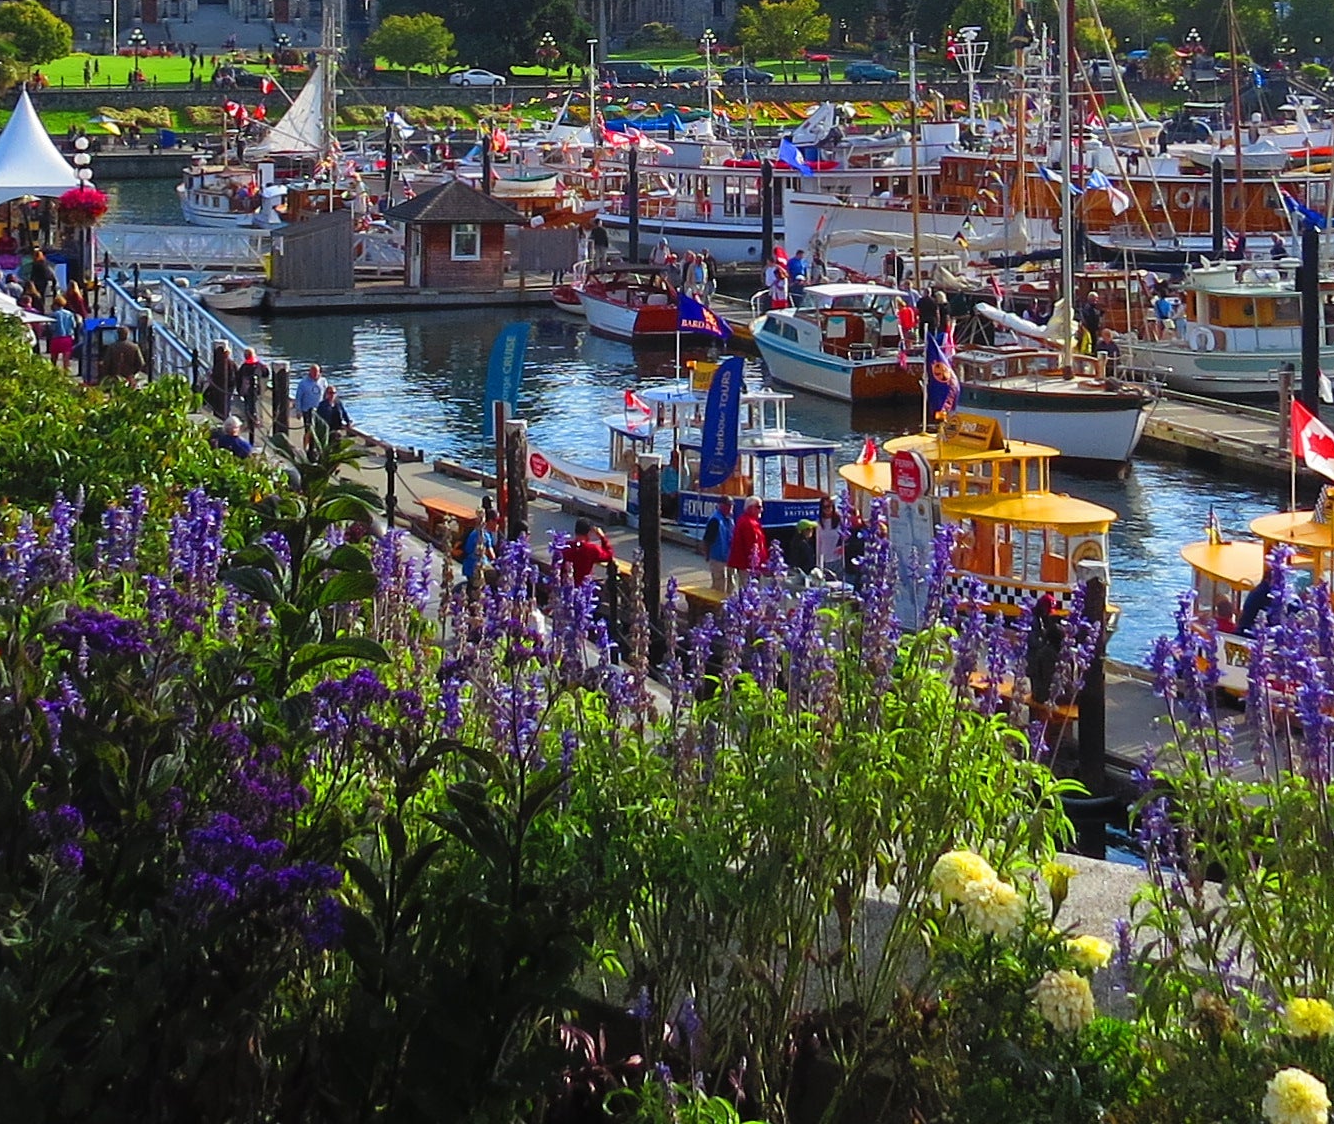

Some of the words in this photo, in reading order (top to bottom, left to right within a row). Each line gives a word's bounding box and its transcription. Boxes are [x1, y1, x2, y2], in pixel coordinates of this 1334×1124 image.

[503, 335, 516, 375] CRUISE
[502, 376, 512, 400] orge
[719, 370, 732, 409] TOURS
[715, 411, 726, 456] Harbour
[683, 498, 718, 518] #EXPLOR
